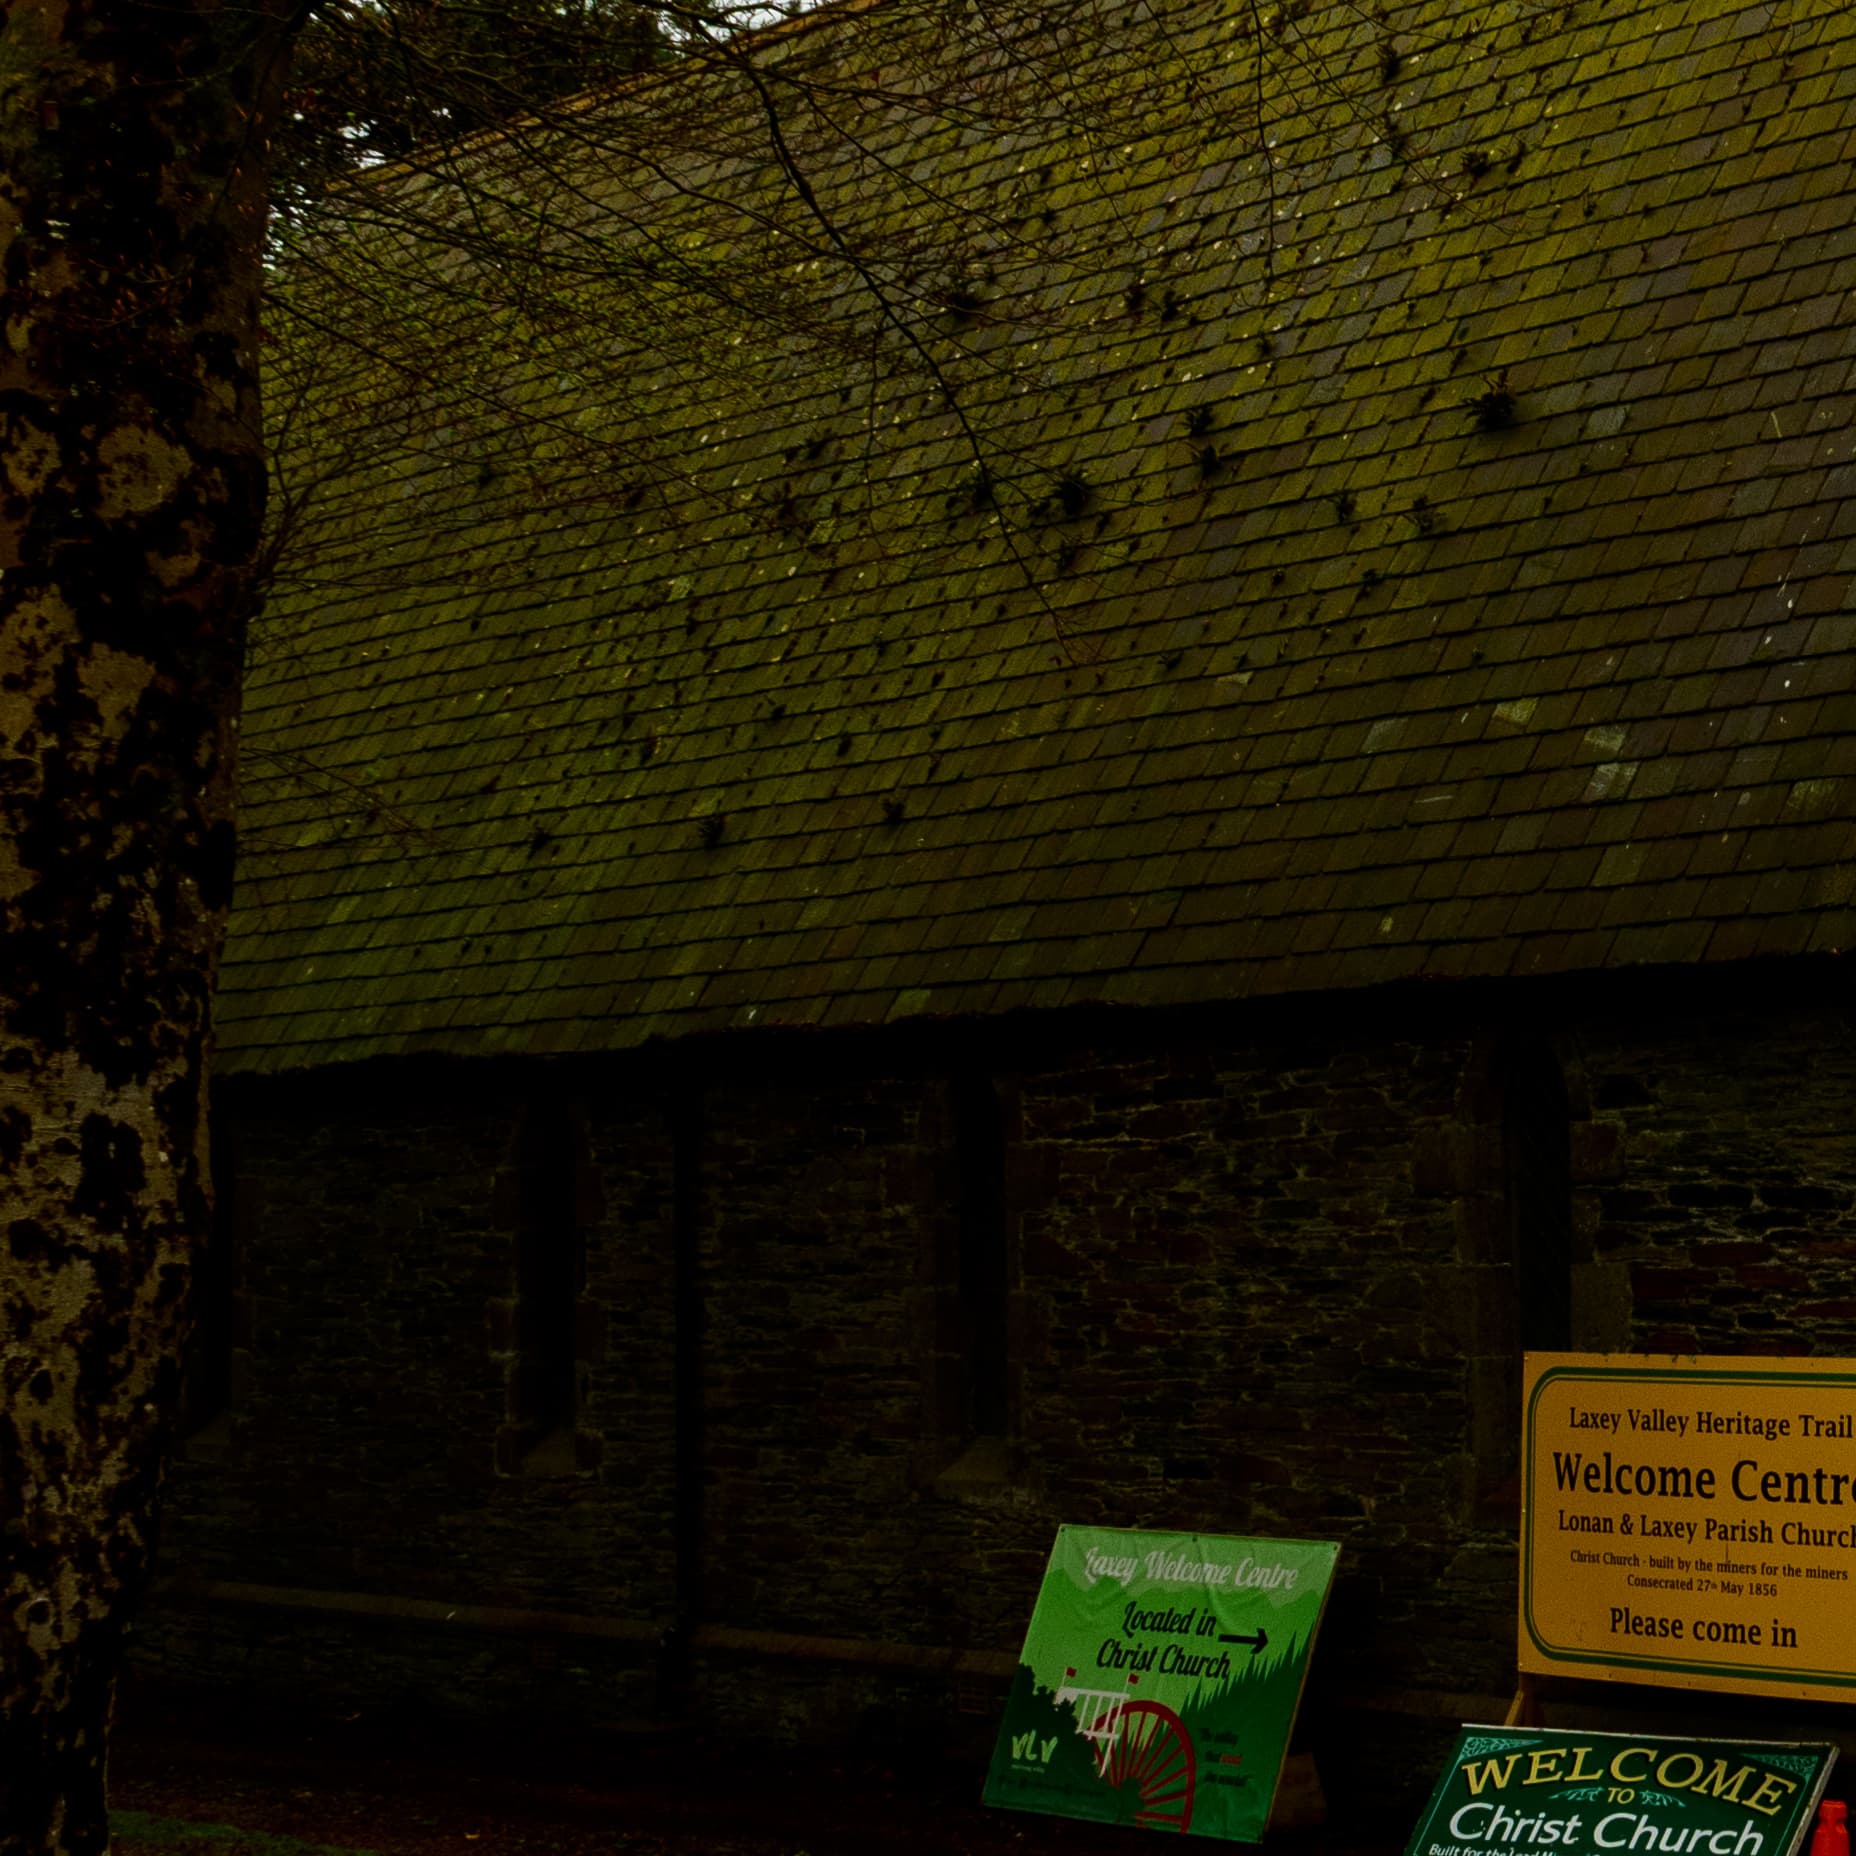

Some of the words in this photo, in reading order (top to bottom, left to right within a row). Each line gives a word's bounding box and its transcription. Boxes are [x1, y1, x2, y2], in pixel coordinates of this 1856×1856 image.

[1569, 1407, 1621, 1434] Laxey
[1627, 1409, 1689, 1437] Valley
[1696, 1412, 1791, 1441] Heritage
[1799, 1415, 1853, 1438] Trail
[1553, 1451, 1716, 1499] Welcome
[1558, 1510, 1614, 1533] Lonan
[1620, 1514, 1634, 1535] &
[1640, 1515, 1698, 1543] Laxey
[1705, 1518, 1773, 1544] Parish
[1084, 1546, 1139, 1587] Laxey
[1144, 1550, 1232, 1585] Welcome
[1235, 1557, 1299, 1590] Centre
[1570, 1549, 1600, 1563] Christ
[1602, 1551, 1640, 1567] Church
[1649, 1555, 1674, 1570] built
[1677, 1557, 1691, 1572] by
[1695, 1558, 1713, 1572] the
[1716, 1560, 1757, 1575] miners
[1760, 1562, 1778, 1576] for
[1782, 1563, 1802, 1577] the
[1805, 1565, 1848, 1580] miners
[1627, 1574, 1693, 1591] Consecrated
[1721, 1581, 1744, 1596] May
[1749, 1582, 1778, 1597] 1856
[1121, 1600, 1197, 1638] Located
[1196, 1609, 1217, 1637] in
[1609, 1607, 1684, 1639] Please
[1693, 1620, 1762, 1645] come
[1771, 1618, 1798, 1648] in
[1096, 1638, 1158, 1671] Christ
[1159, 1644, 1230, 1680] Church
[1461, 1746, 1798, 1817] WELCOME
[1607, 1786, 1636, 1805] TO
[1448, 1802, 1582, 1845] Christ
[1592, 1811, 1765, 1856] Church
[1428, 1843, 1458, 1856] Built
